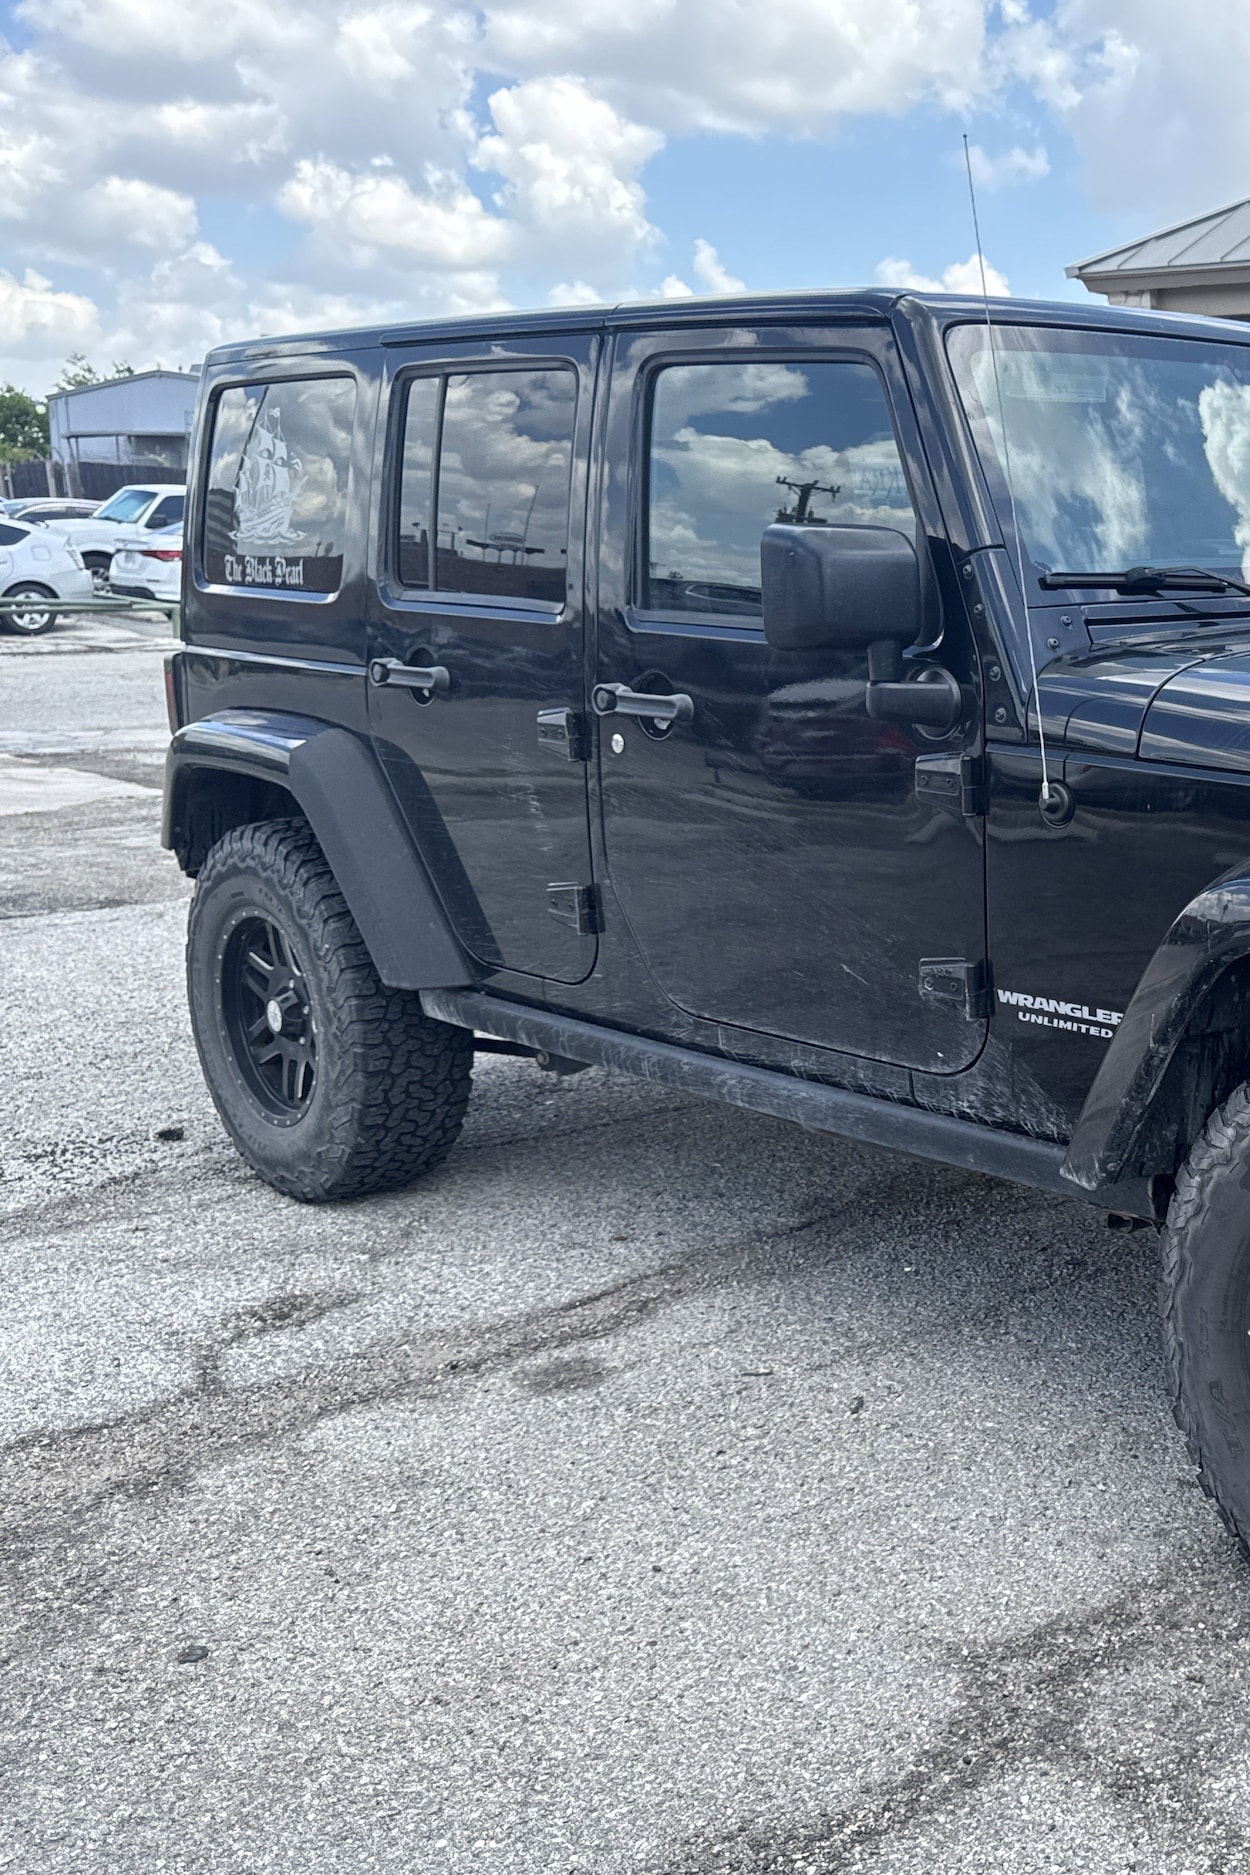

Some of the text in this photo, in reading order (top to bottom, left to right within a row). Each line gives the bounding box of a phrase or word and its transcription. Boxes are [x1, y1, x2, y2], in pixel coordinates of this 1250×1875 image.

[224, 555, 304, 585] The Black Pearl
[1018, 1012, 1114, 1038] UNLIMITED
